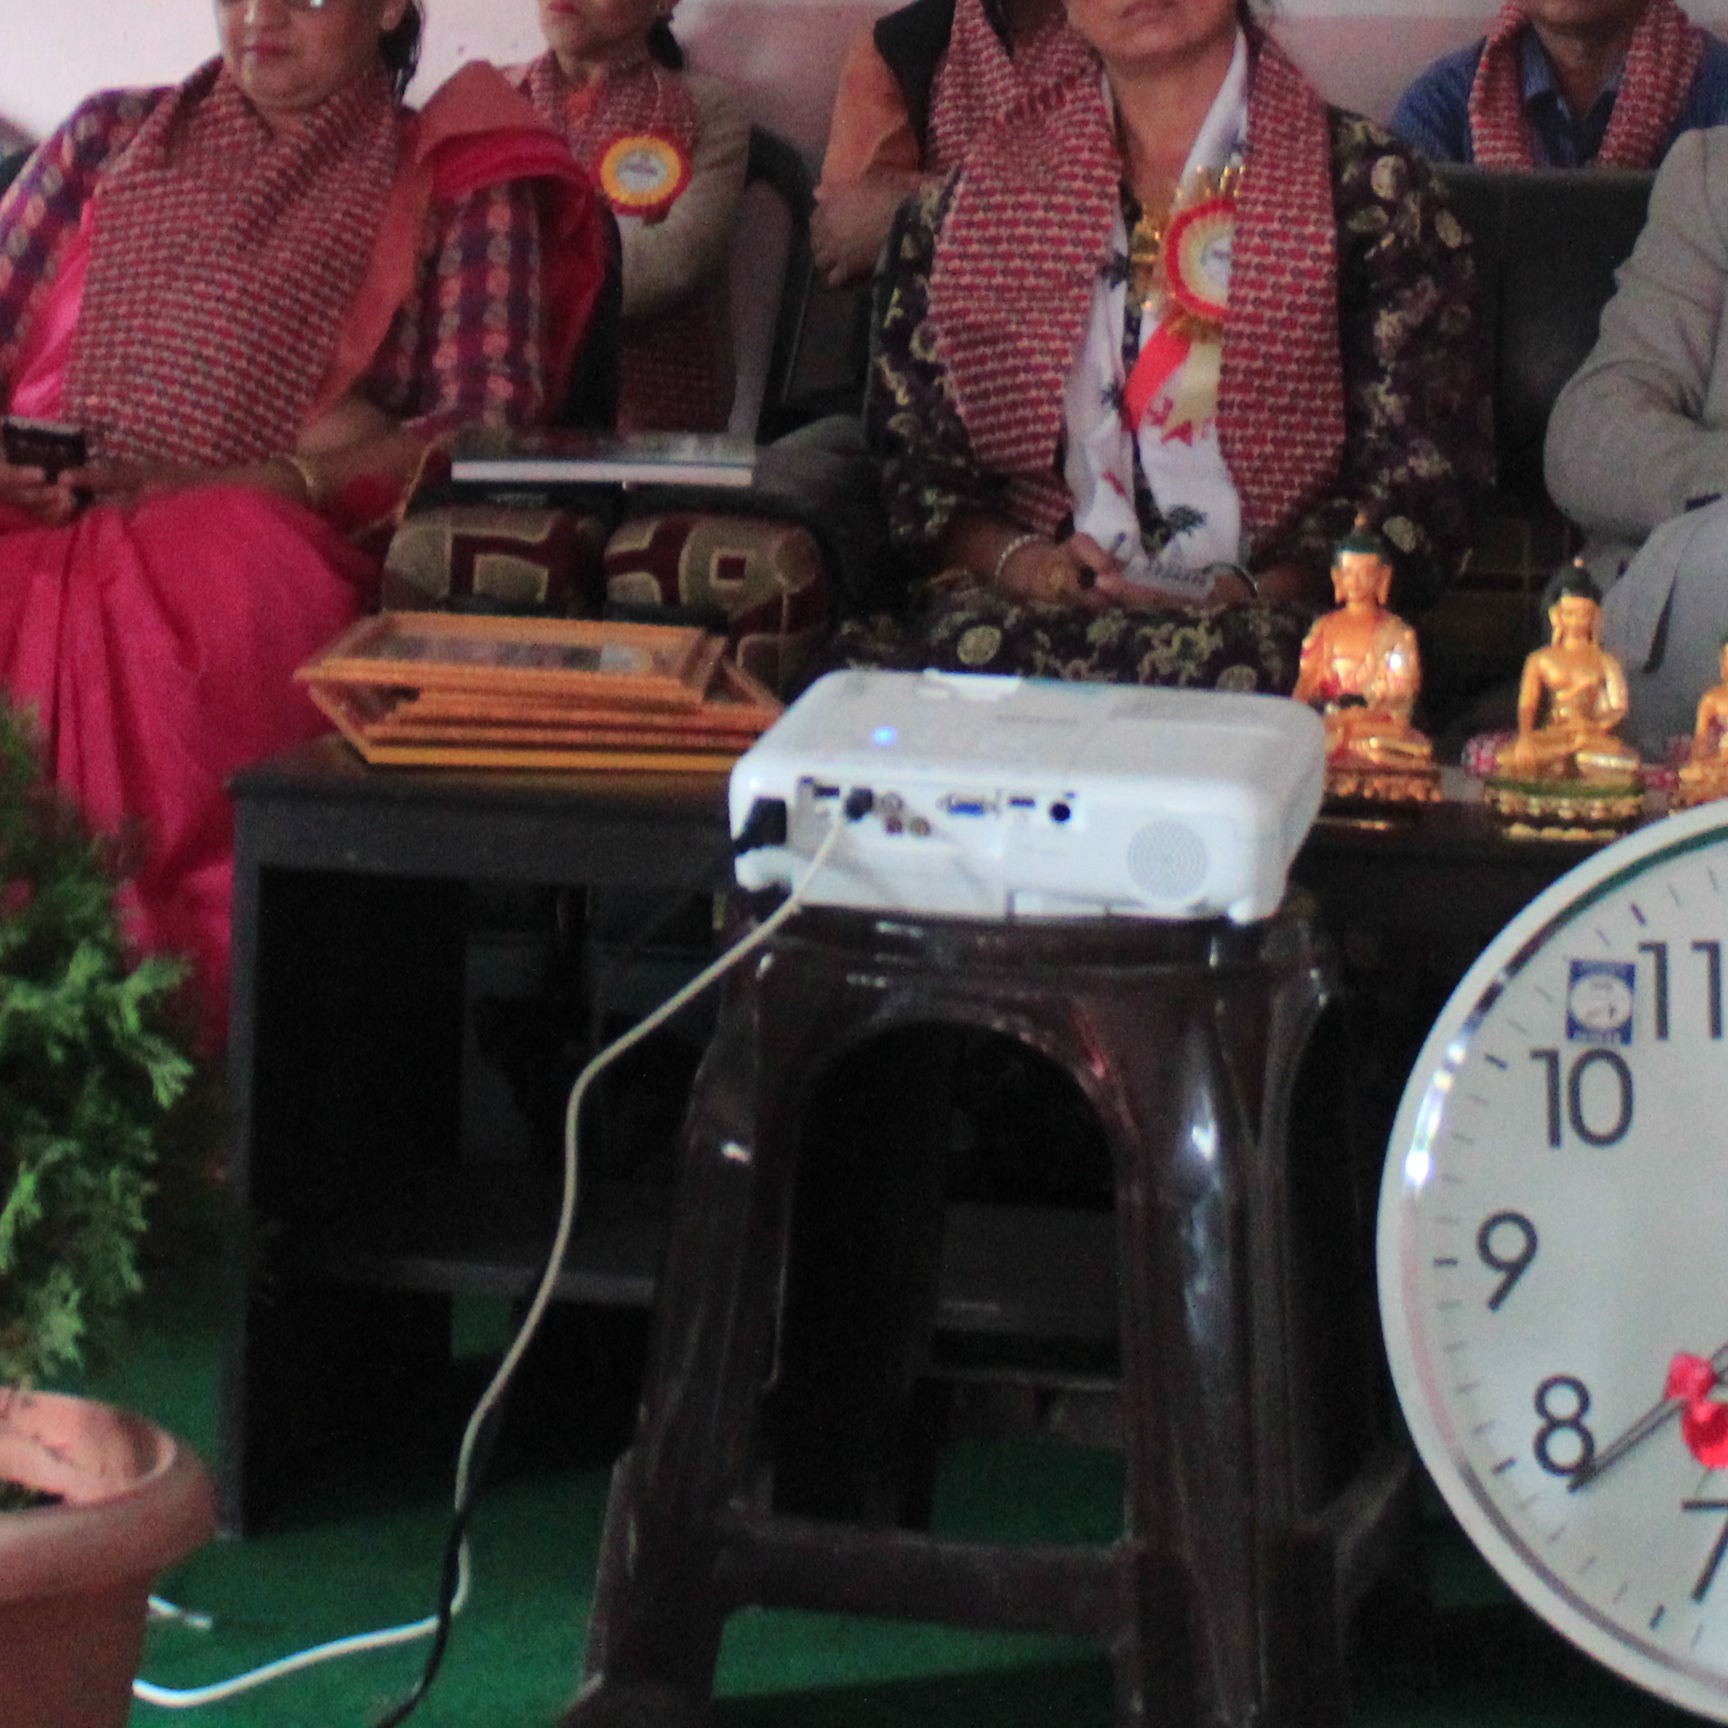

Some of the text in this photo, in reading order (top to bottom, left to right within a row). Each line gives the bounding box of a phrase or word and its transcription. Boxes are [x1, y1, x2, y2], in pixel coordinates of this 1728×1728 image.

[1638, 940, 1725, 1040] 11
[1530, 1048, 1635, 1149] 10
[1476, 1210, 1538, 1312] 9
[1533, 1375, 1595, 1477] 8
